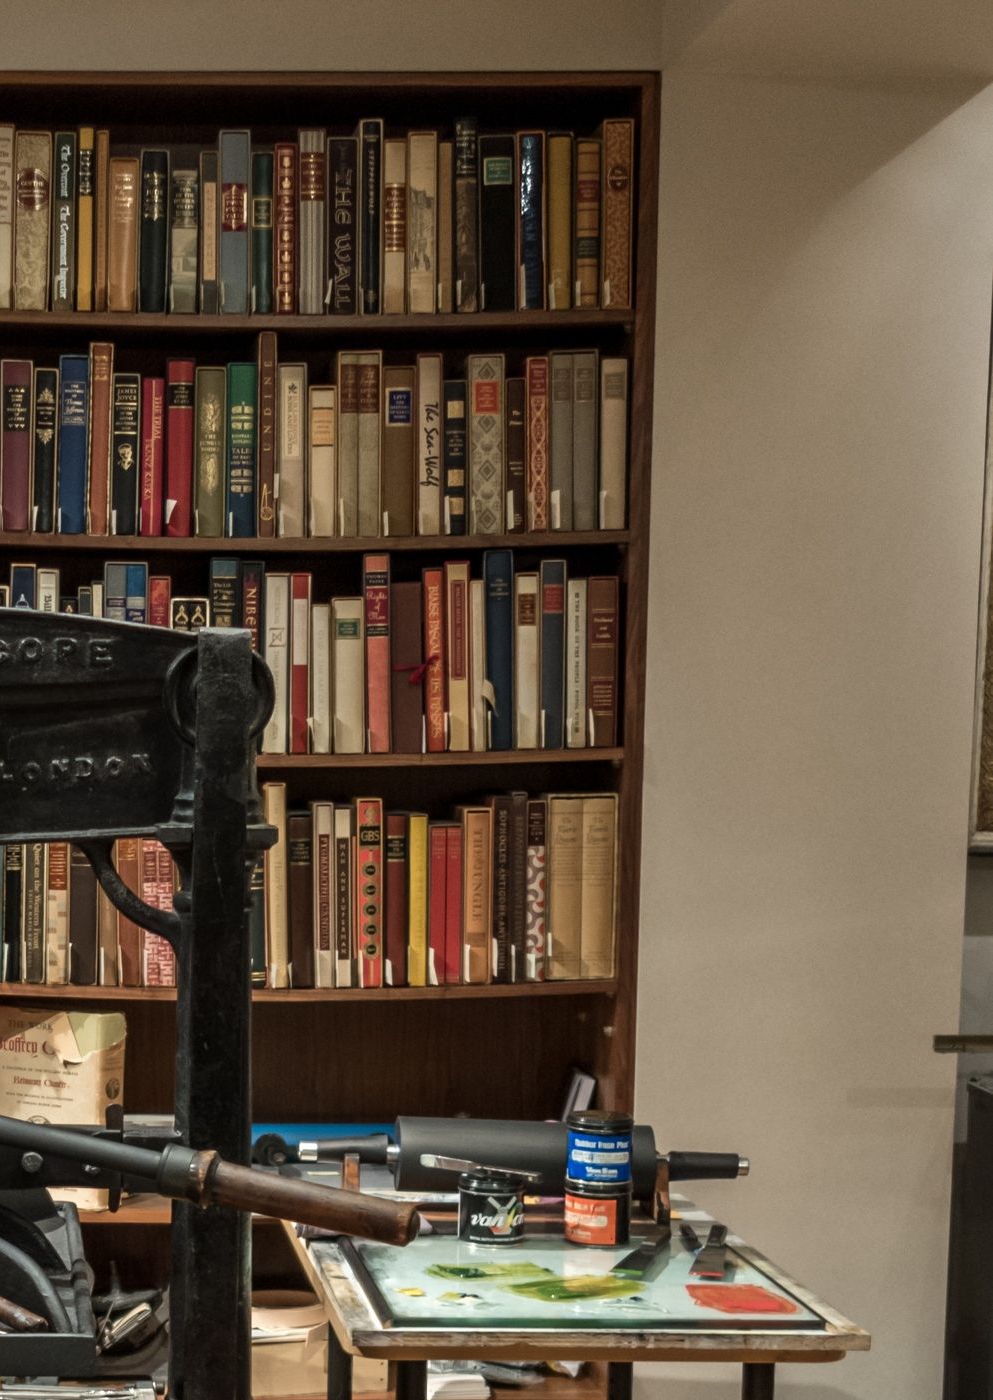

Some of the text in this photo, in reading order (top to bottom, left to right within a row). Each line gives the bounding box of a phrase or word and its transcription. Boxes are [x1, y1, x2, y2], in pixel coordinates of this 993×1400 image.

[333, 167, 353, 309] THE WALL
[154, 396, 162, 441] THE TRIAL
[263, 360, 272, 452] UNDINE
[421, 402, 440, 488] The Sea-Wolf
[143, 439, 152, 501] FRANZ KAFKA
[361, 830, 380, 843] GBS
[472, 828, 484, 922] THE JUNGLE
[32, 843, 43, 949] Quiet on the Western Front
[6, 1019, 24, 1028] THE
